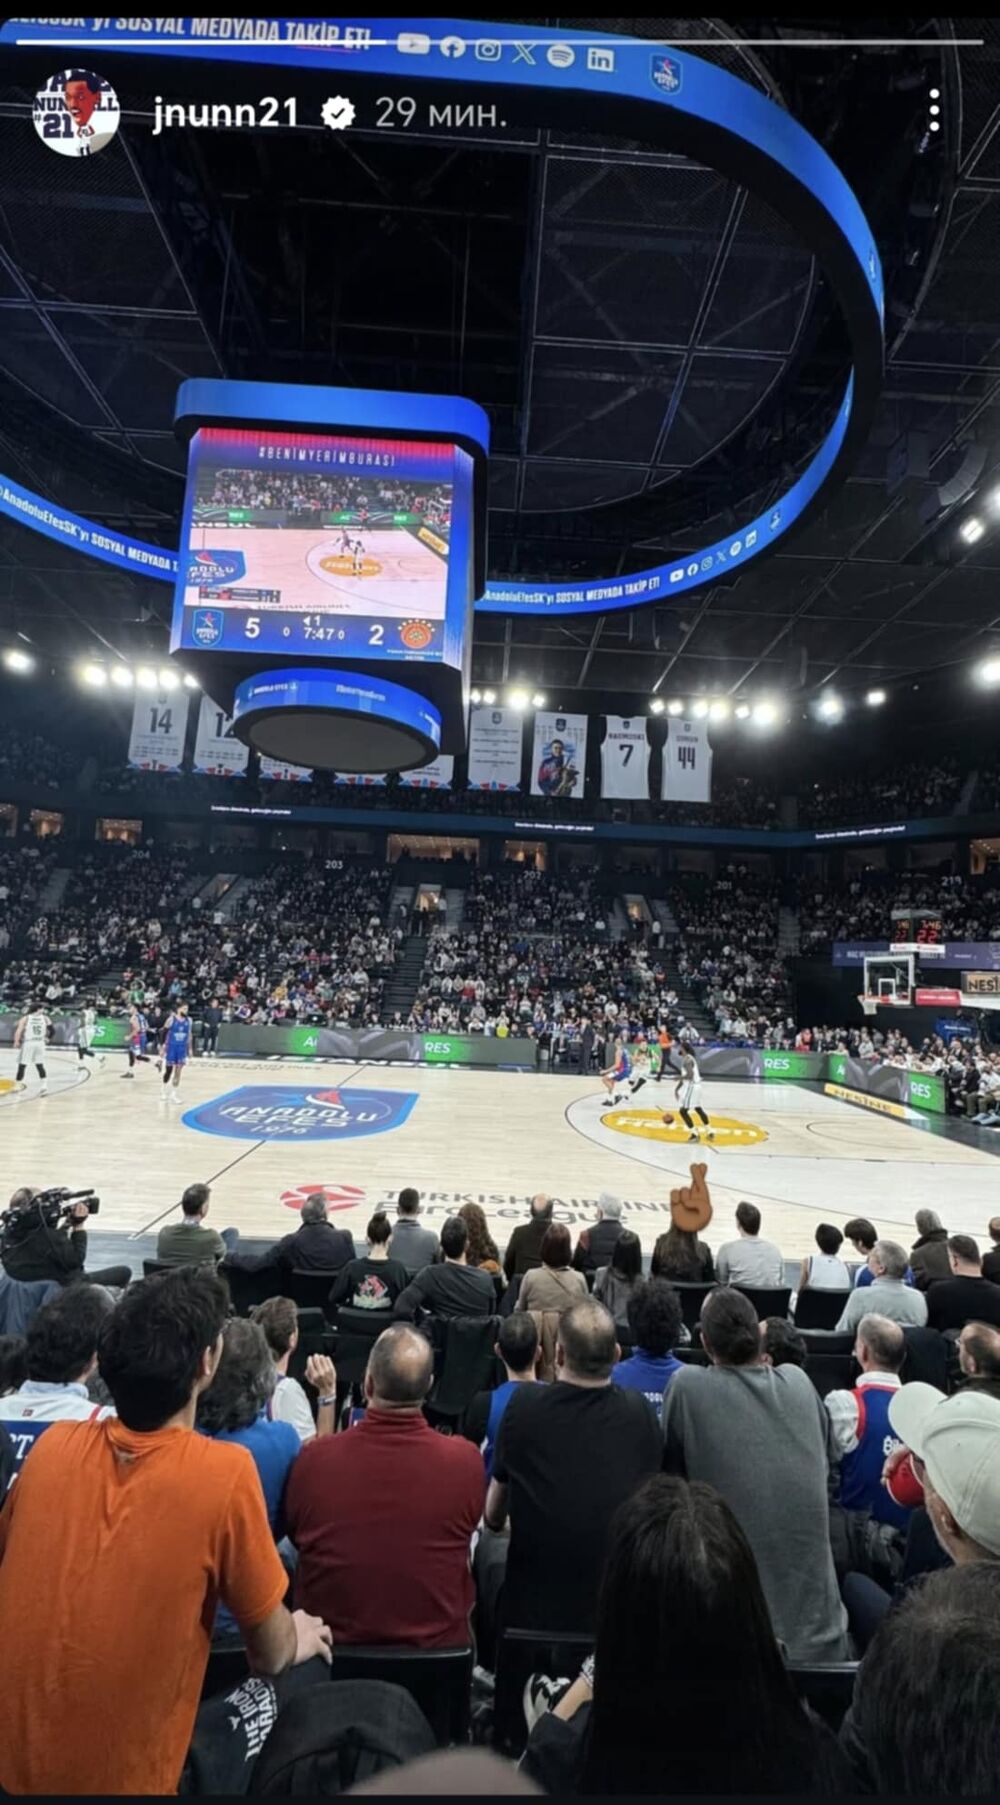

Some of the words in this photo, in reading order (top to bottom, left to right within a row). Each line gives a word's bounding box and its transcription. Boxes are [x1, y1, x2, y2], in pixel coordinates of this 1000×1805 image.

[190, 18, 280, 42] MEDYADA
[91, 532, 127, 557] SOSYAL
[128, 548, 171, 571] MEDYADA
[556, 591, 584, 604] SOSYAL
[586, 587, 623, 601] MEDYADA
[625, 580, 648, 595] TAKİP
[244, 617, 260, 638] 5
[304, 626, 334, 641] 7:47
[369, 627, 384, 648] 2
[150, 707, 173, 734] 14
[619, 744, 634, 767] 7
[678, 746, 696, 770] 44
[324, 860, 343, 869] 203
[424, 1041, 451, 1054] RES
[764, 1058, 790, 1071] RES
[219, 1105, 379, 1123] ANADOLU
